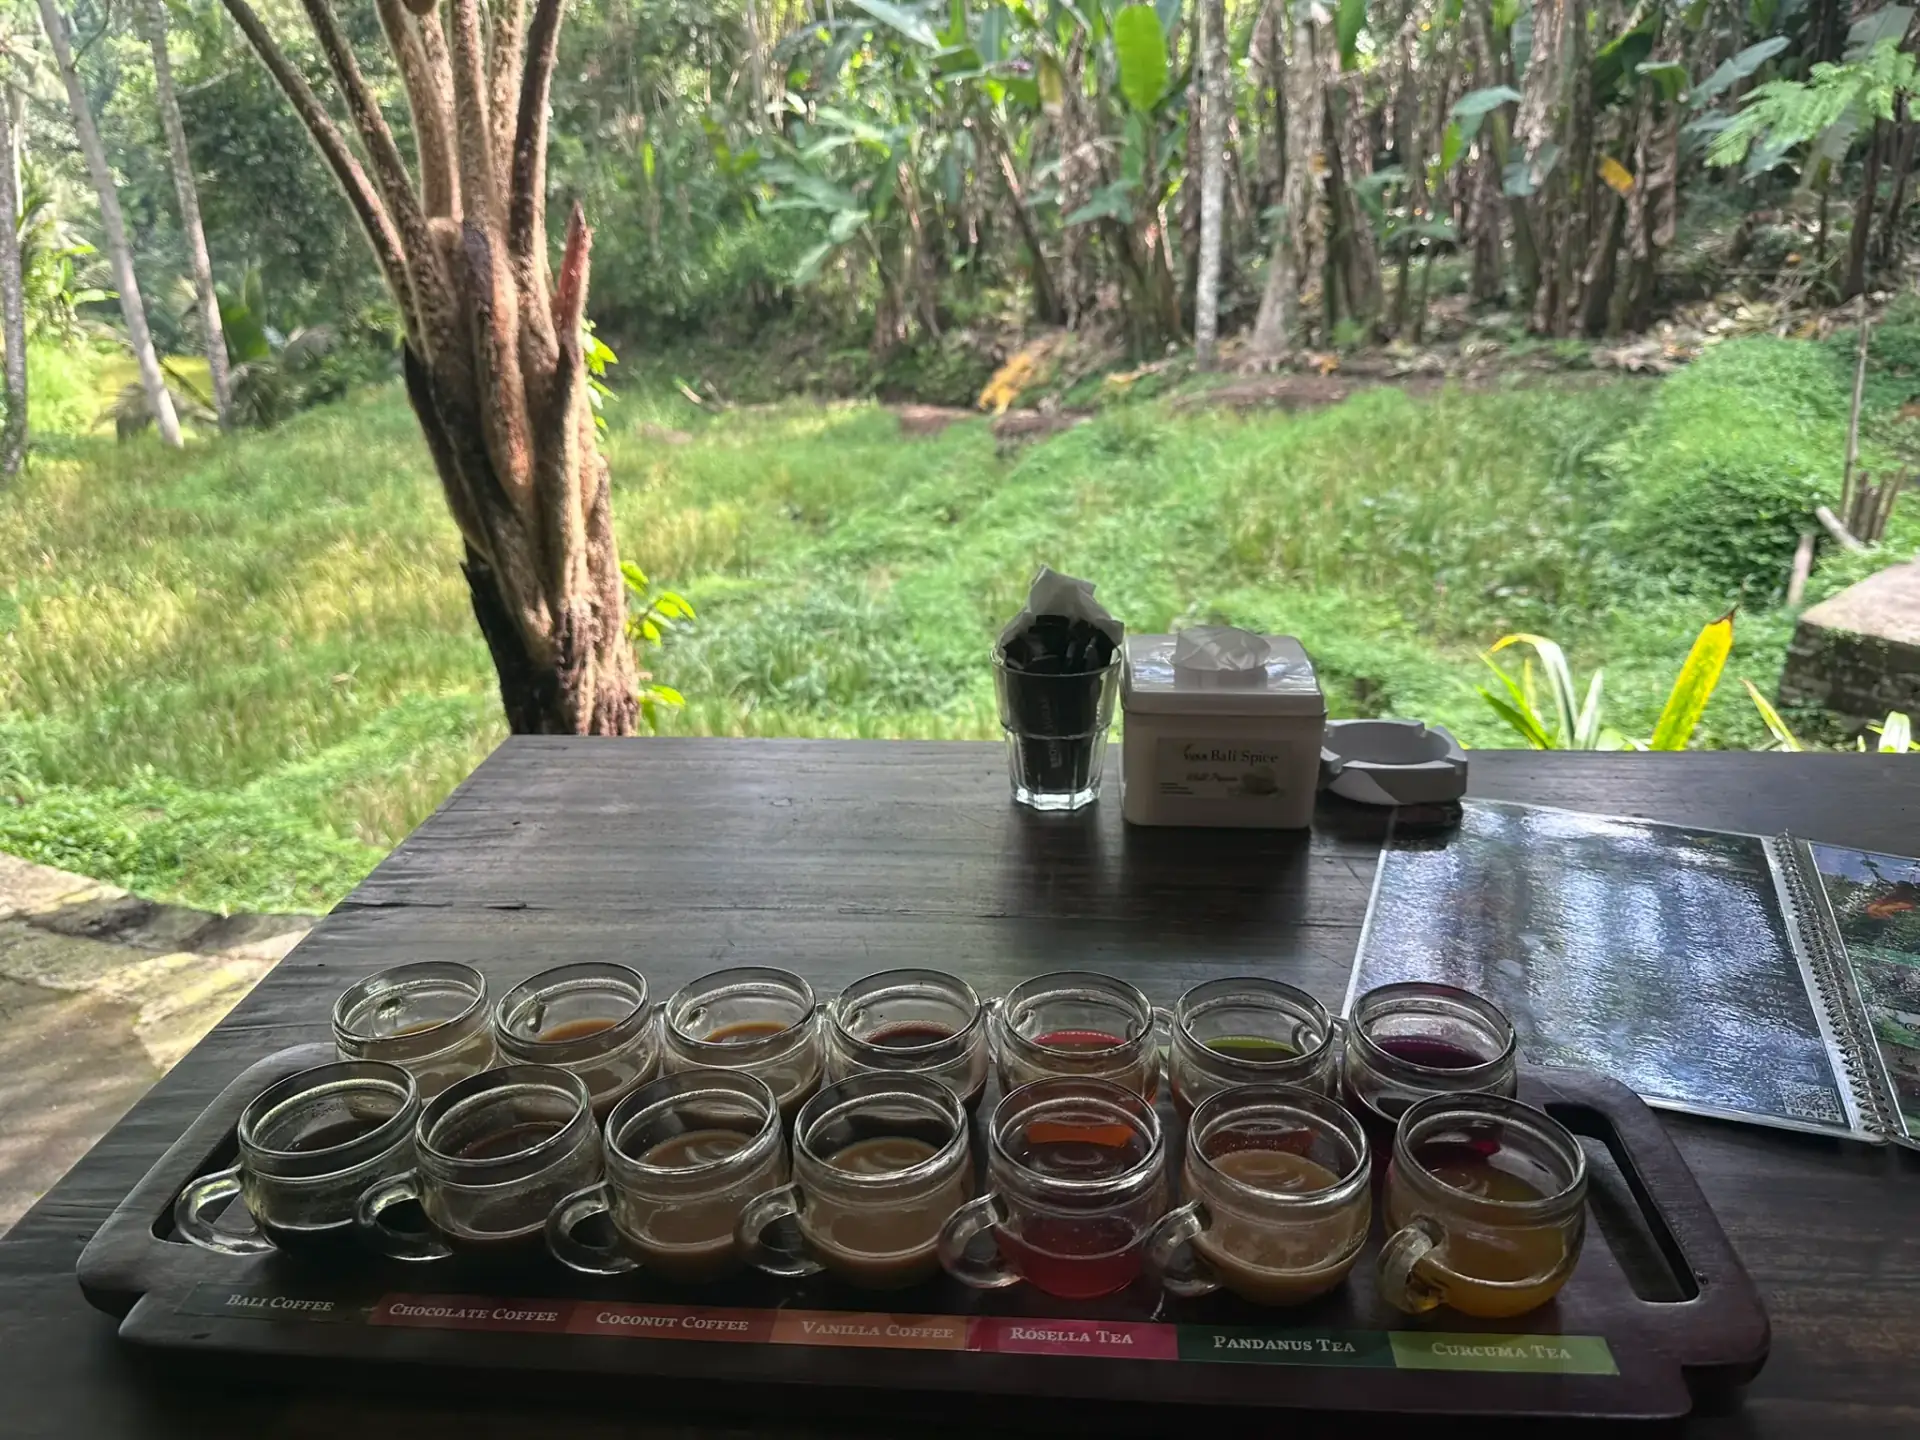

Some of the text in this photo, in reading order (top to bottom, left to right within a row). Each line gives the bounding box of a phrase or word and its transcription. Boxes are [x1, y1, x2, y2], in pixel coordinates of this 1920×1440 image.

[1210, 749, 1237, 763] Bali
[1241, 749, 1279, 766] Spice
[225, 1293, 335, 1312] BALI COFFEE
[389, 1303, 558, 1322] CHOCOLATE COFFEE
[596, 1311, 749, 1332] COCONUT COFFEE
[801, 1320, 954, 1339] VANILLA COFFEE
[1010, 1326, 1134, 1345] ROSELLA TEA
[1213, 1335, 1356, 1353] PANDANUS TEA
[1431, 1341, 1573, 1361] CURCUMA TEA
